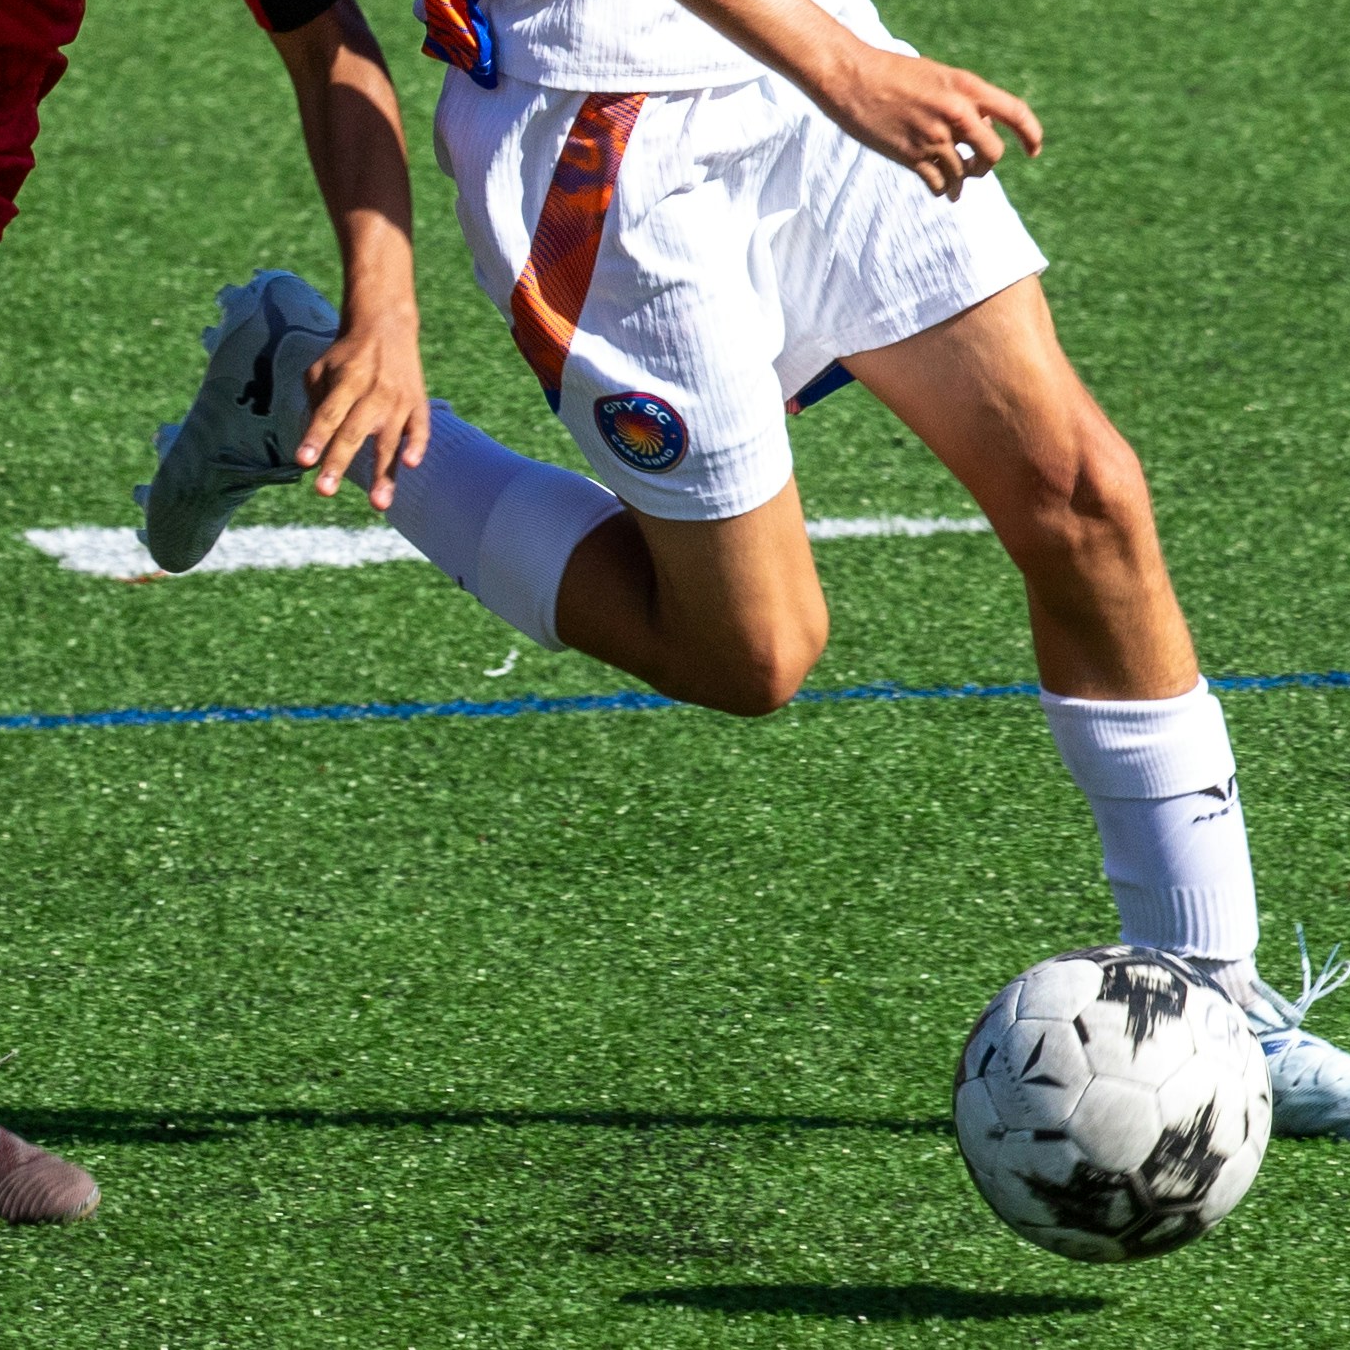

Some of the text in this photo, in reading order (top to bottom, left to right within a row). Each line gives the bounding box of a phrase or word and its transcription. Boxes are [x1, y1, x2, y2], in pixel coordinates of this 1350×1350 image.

[603, 400, 671, 425] CITY SC
[611, 434, 674, 466] CARLSBAD
